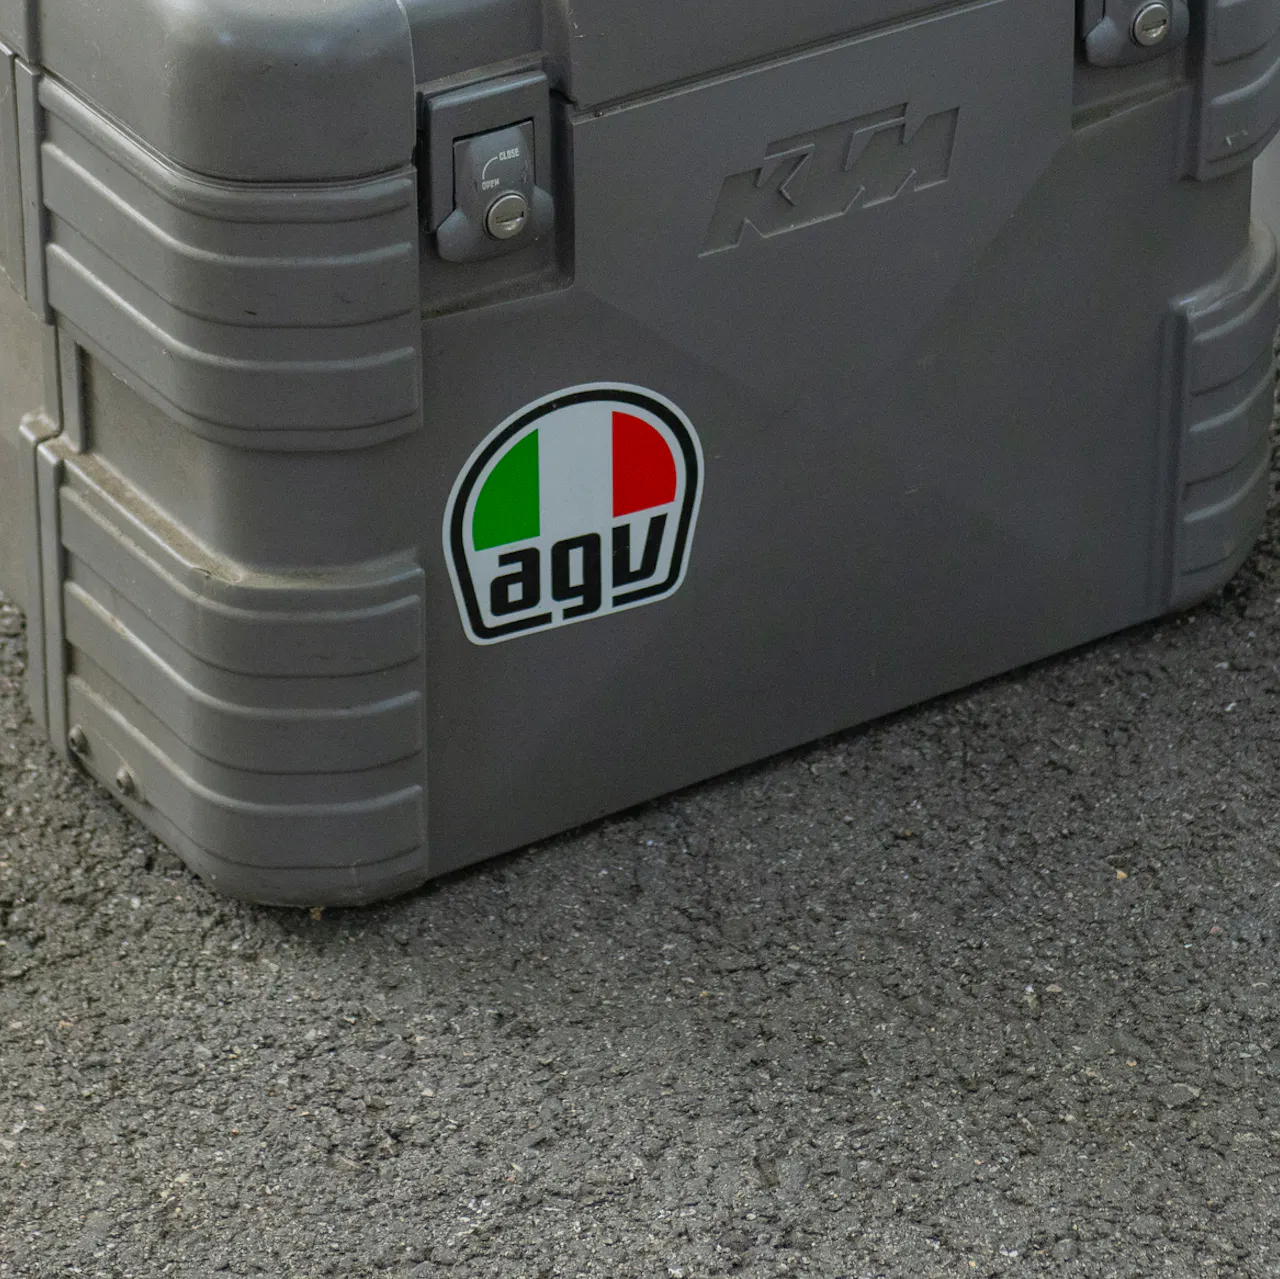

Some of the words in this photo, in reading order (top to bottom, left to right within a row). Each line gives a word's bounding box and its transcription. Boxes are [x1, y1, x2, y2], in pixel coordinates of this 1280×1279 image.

[481, 177, 501, 191] OPEN
[498, 147, 520, 161] CLOSE
[697, 102, 960, 259] KTM
[490, 513, 668, 620] agv
